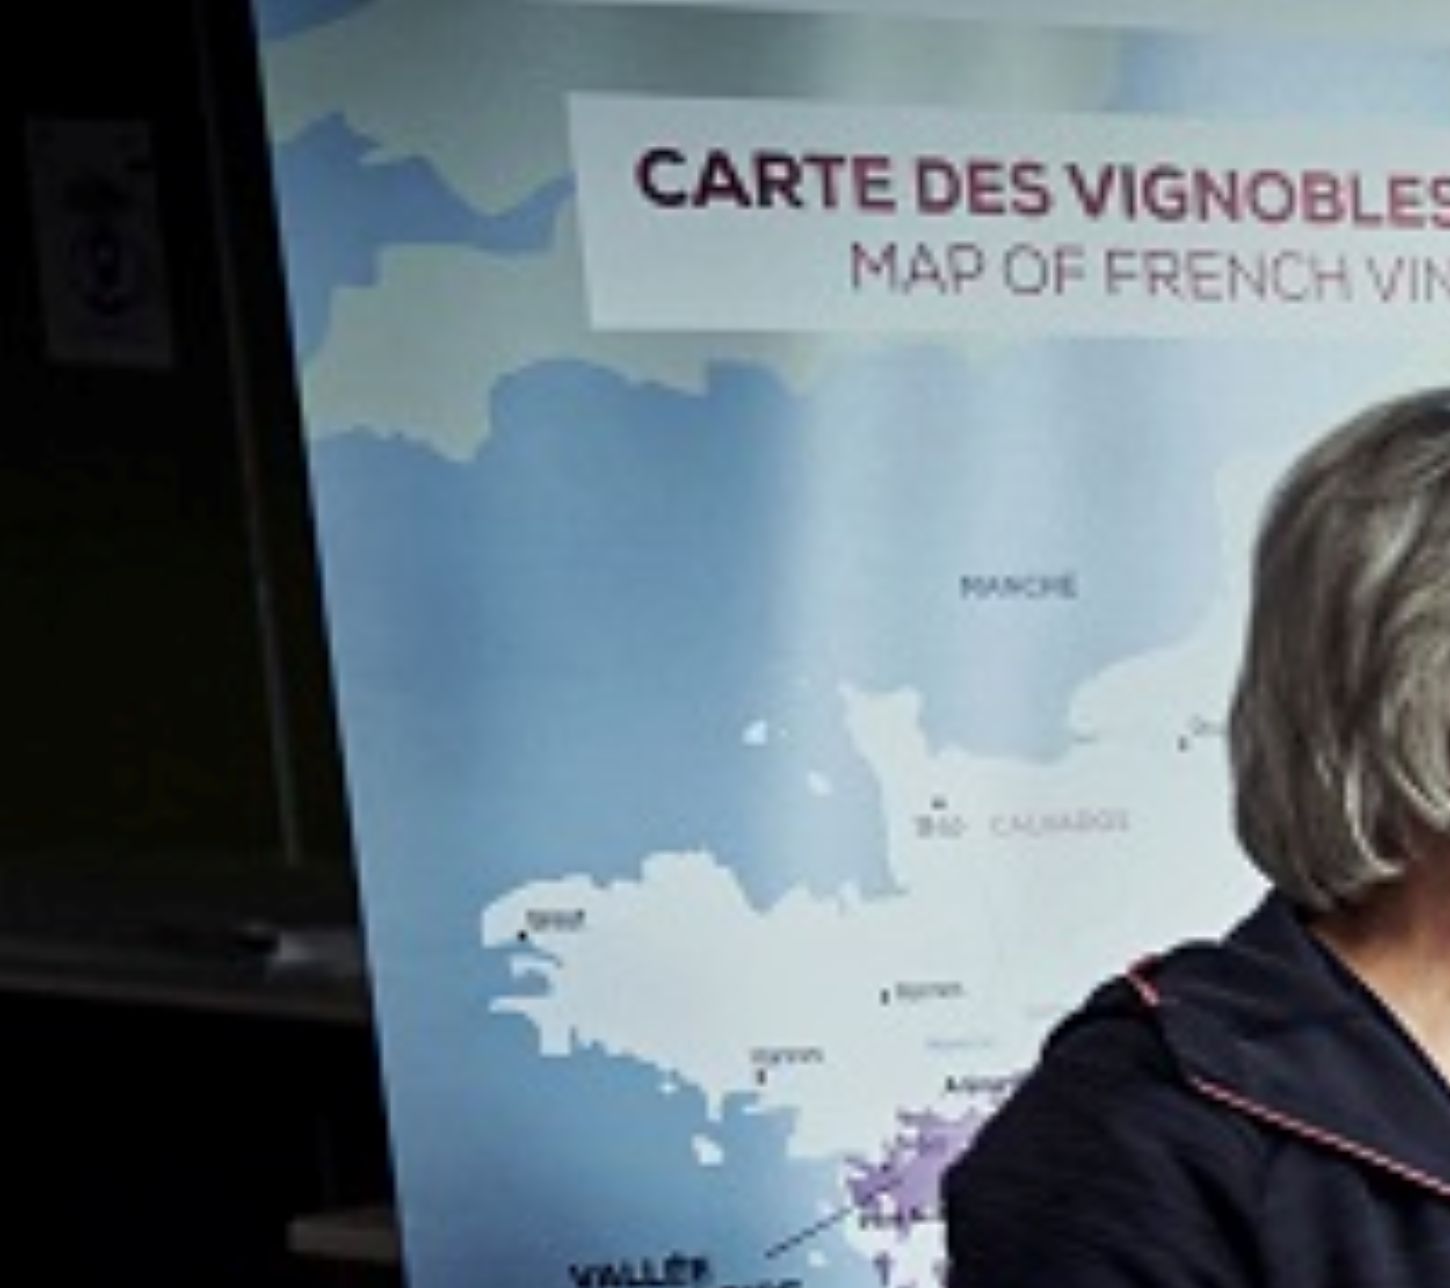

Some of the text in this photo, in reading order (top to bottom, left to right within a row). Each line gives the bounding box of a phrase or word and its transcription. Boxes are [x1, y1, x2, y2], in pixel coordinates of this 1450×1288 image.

[636, 147, 896, 210] CARTE
[915, 157, 1051, 217] DES
[852, 242, 984, 296] MAP
[1004, 244, 1087, 297] OF
[1106, 247, 1351, 302] FRENCH
[959, 571, 1077, 600] MANCHE
